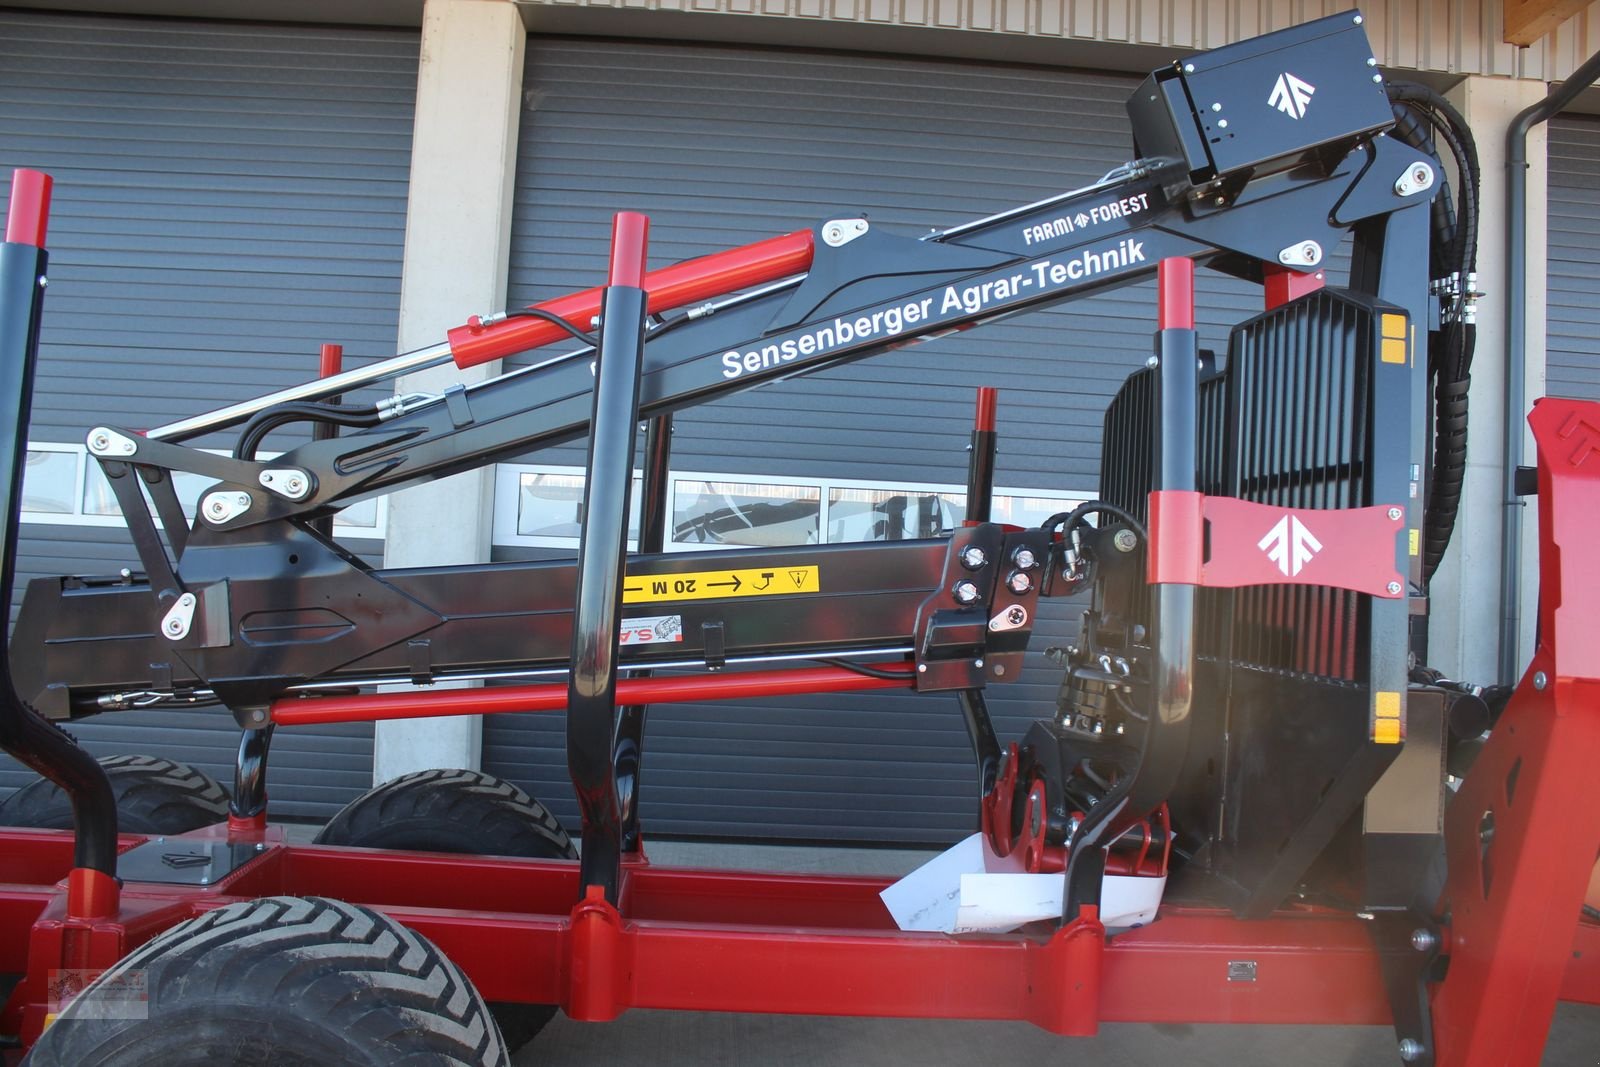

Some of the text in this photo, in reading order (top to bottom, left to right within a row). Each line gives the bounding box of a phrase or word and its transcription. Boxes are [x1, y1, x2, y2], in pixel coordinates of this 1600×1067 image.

[1023, 193, 1150, 246] FARMI FOREST
[722, 239, 1146, 379] Sensenberger Agrar-Technik
[652, 579, 697, 595] 20 M
